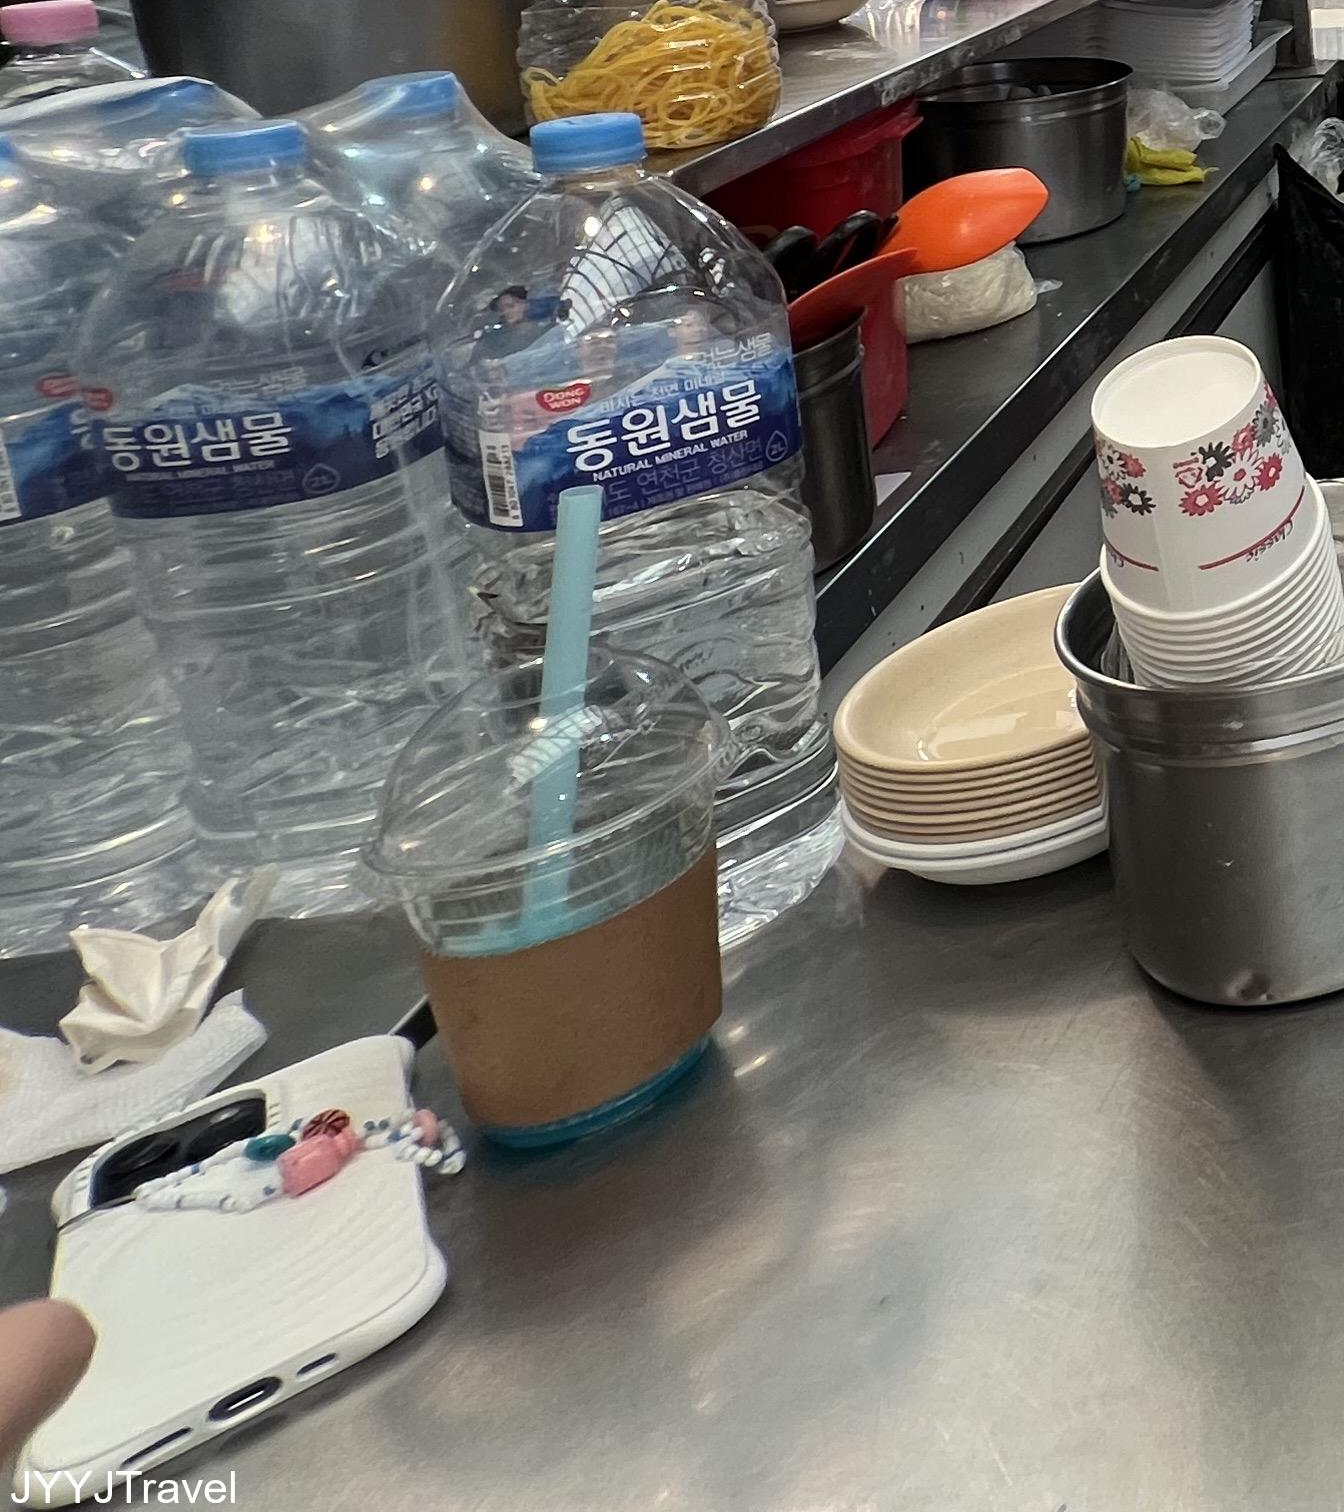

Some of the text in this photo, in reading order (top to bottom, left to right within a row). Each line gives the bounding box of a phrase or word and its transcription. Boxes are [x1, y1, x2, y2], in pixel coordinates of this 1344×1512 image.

[549, 396, 582, 409] WON
[565, 379, 763, 473] 동원샘물
[104, 411, 294, 473] 동원샘물
[592, 428, 749, 482] NATURAL MINERAL WATER
